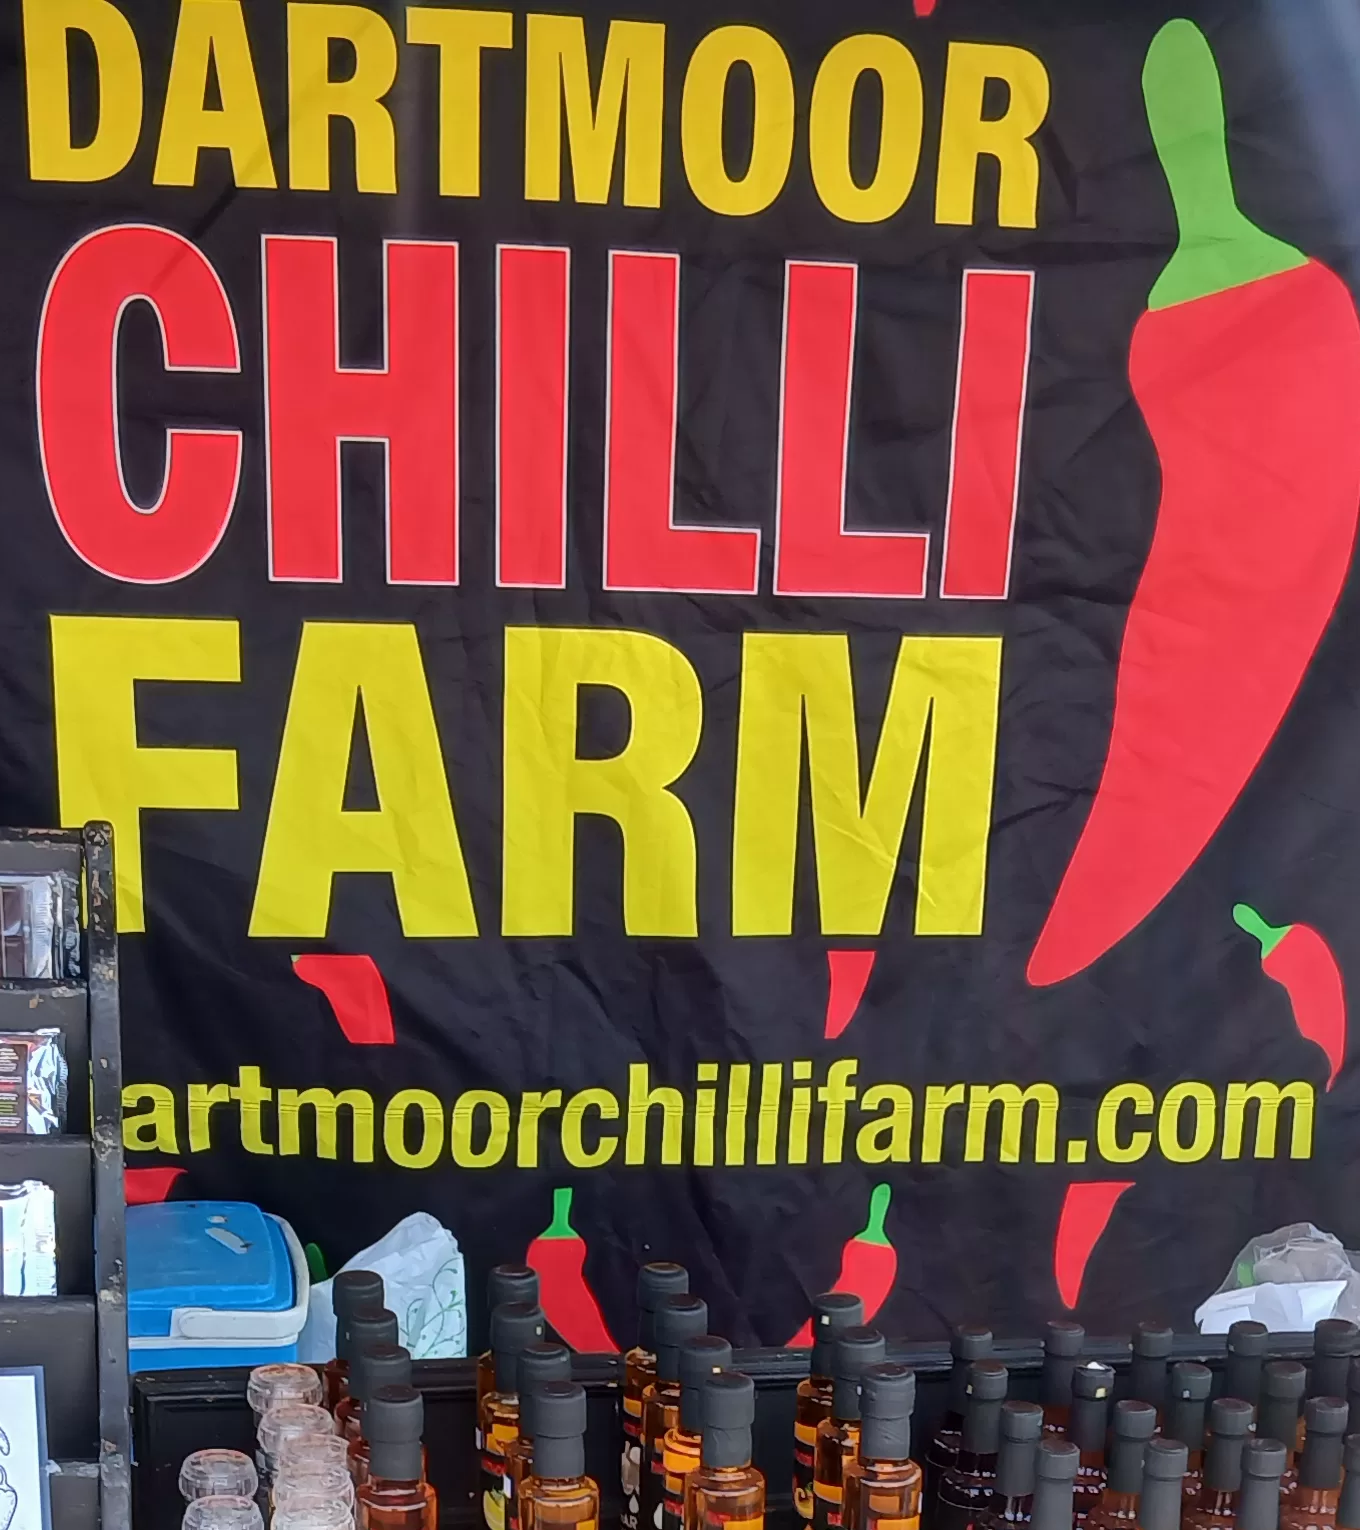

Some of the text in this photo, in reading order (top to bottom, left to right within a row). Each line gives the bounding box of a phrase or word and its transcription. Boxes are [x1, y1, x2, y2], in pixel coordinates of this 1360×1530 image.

[24, 0, 1049, 229] DARTMOOR
[36, 223, 1036, 599] CHILLI
[49, 614, 1004, 938] FARM
[123, 1062, 1315, 1169] artmoorchillifarm.com
